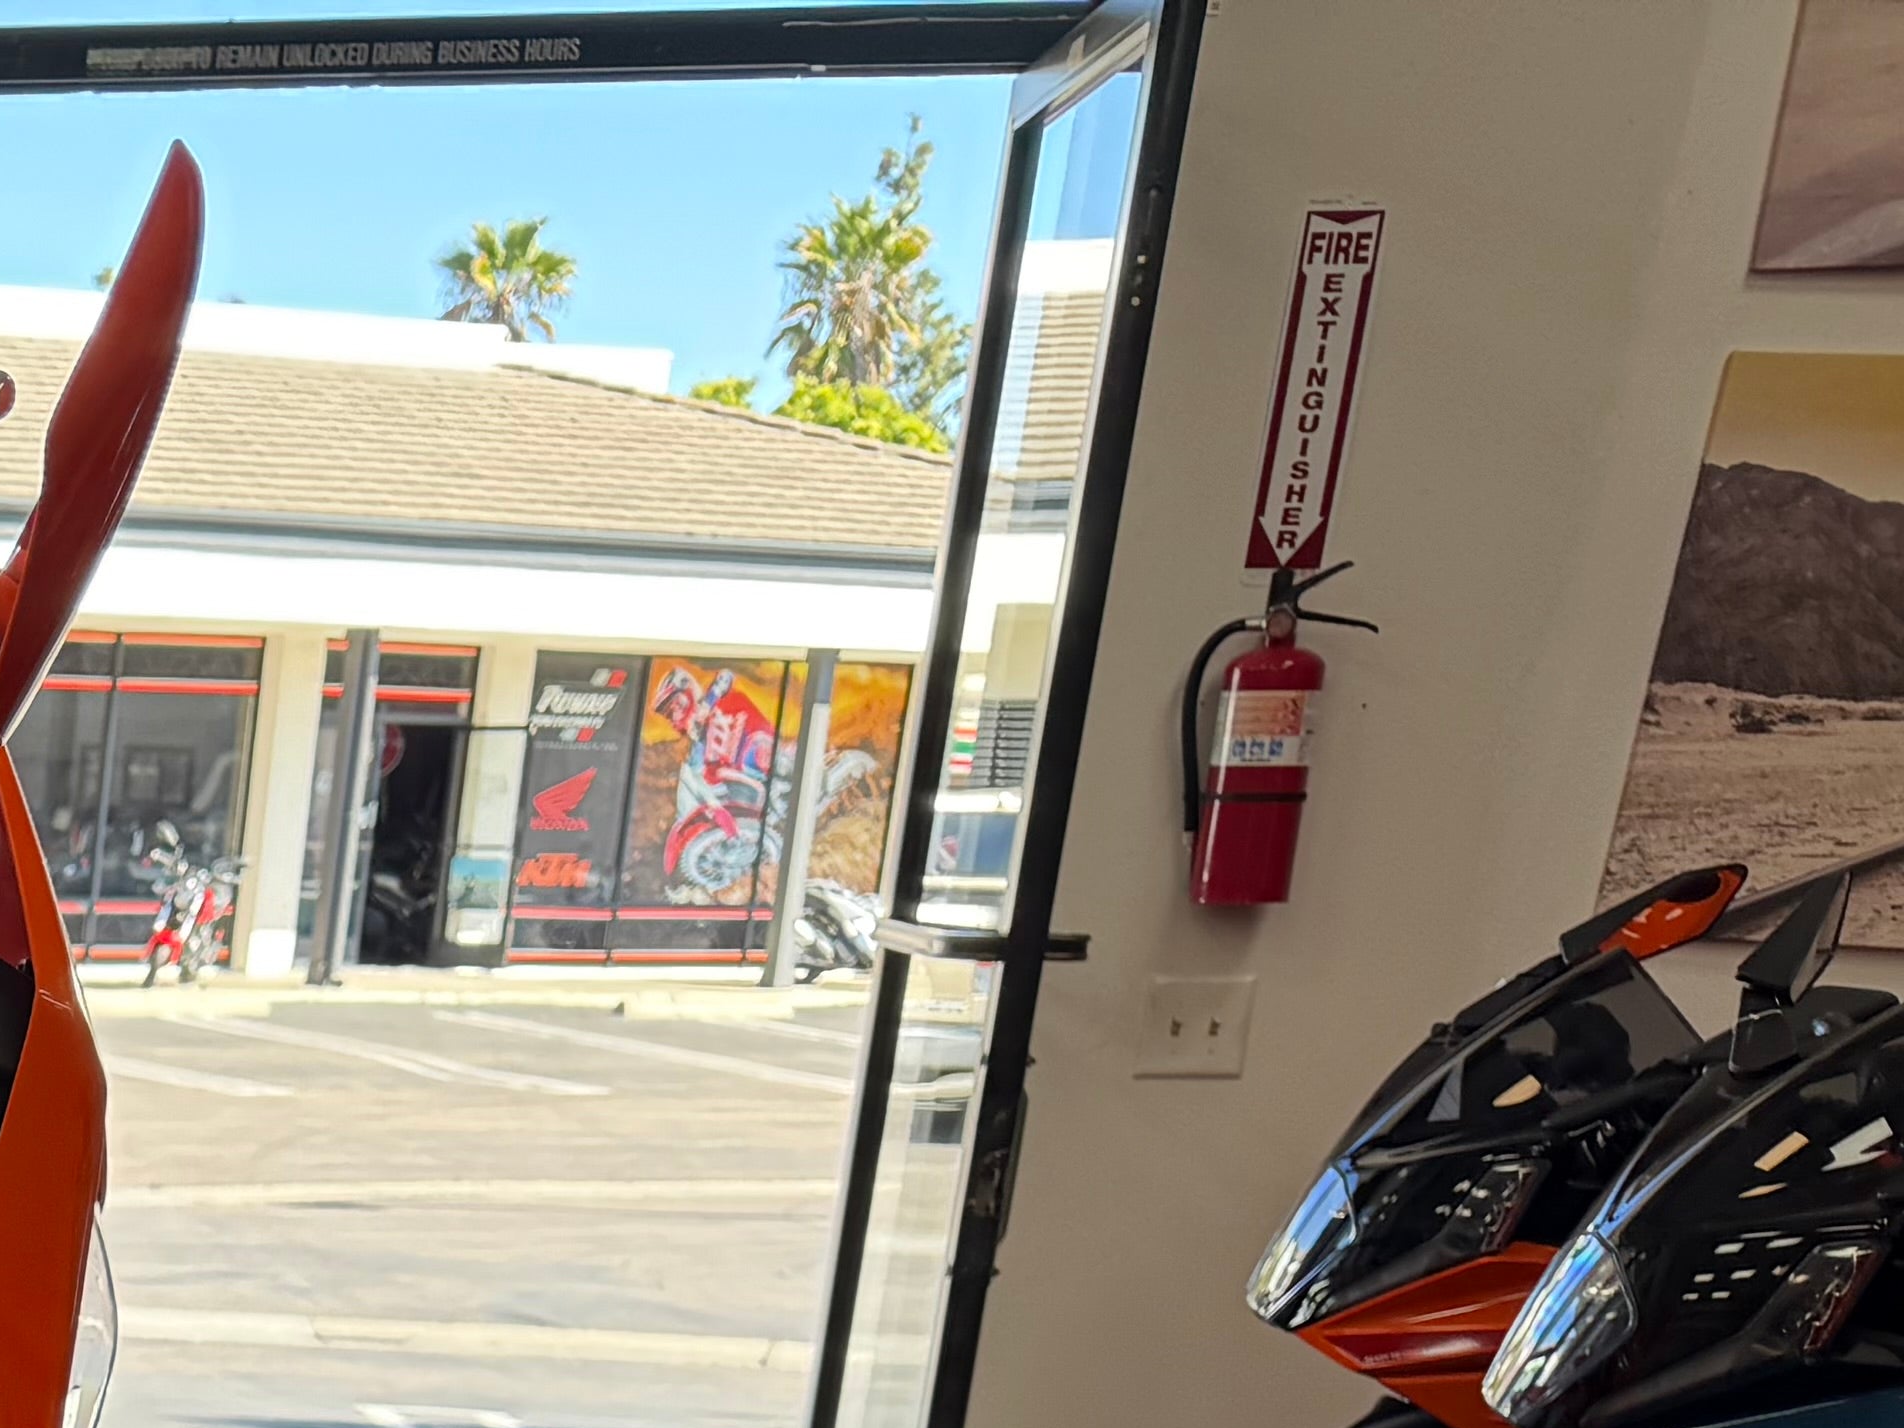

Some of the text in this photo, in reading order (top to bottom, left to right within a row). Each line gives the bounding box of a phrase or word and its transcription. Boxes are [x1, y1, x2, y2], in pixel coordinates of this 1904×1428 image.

[215, 44, 281, 69] REMAIN
[283, 42, 369, 68] UNLOCKED
[372, 41, 433, 65] DURING
[437, 38, 521, 64] BUSINESS
[524, 37, 581, 62] HOURS
[1306, 231, 1373, 265] FIRE
[1275, 272, 1346, 550] EXTINGUISHER
